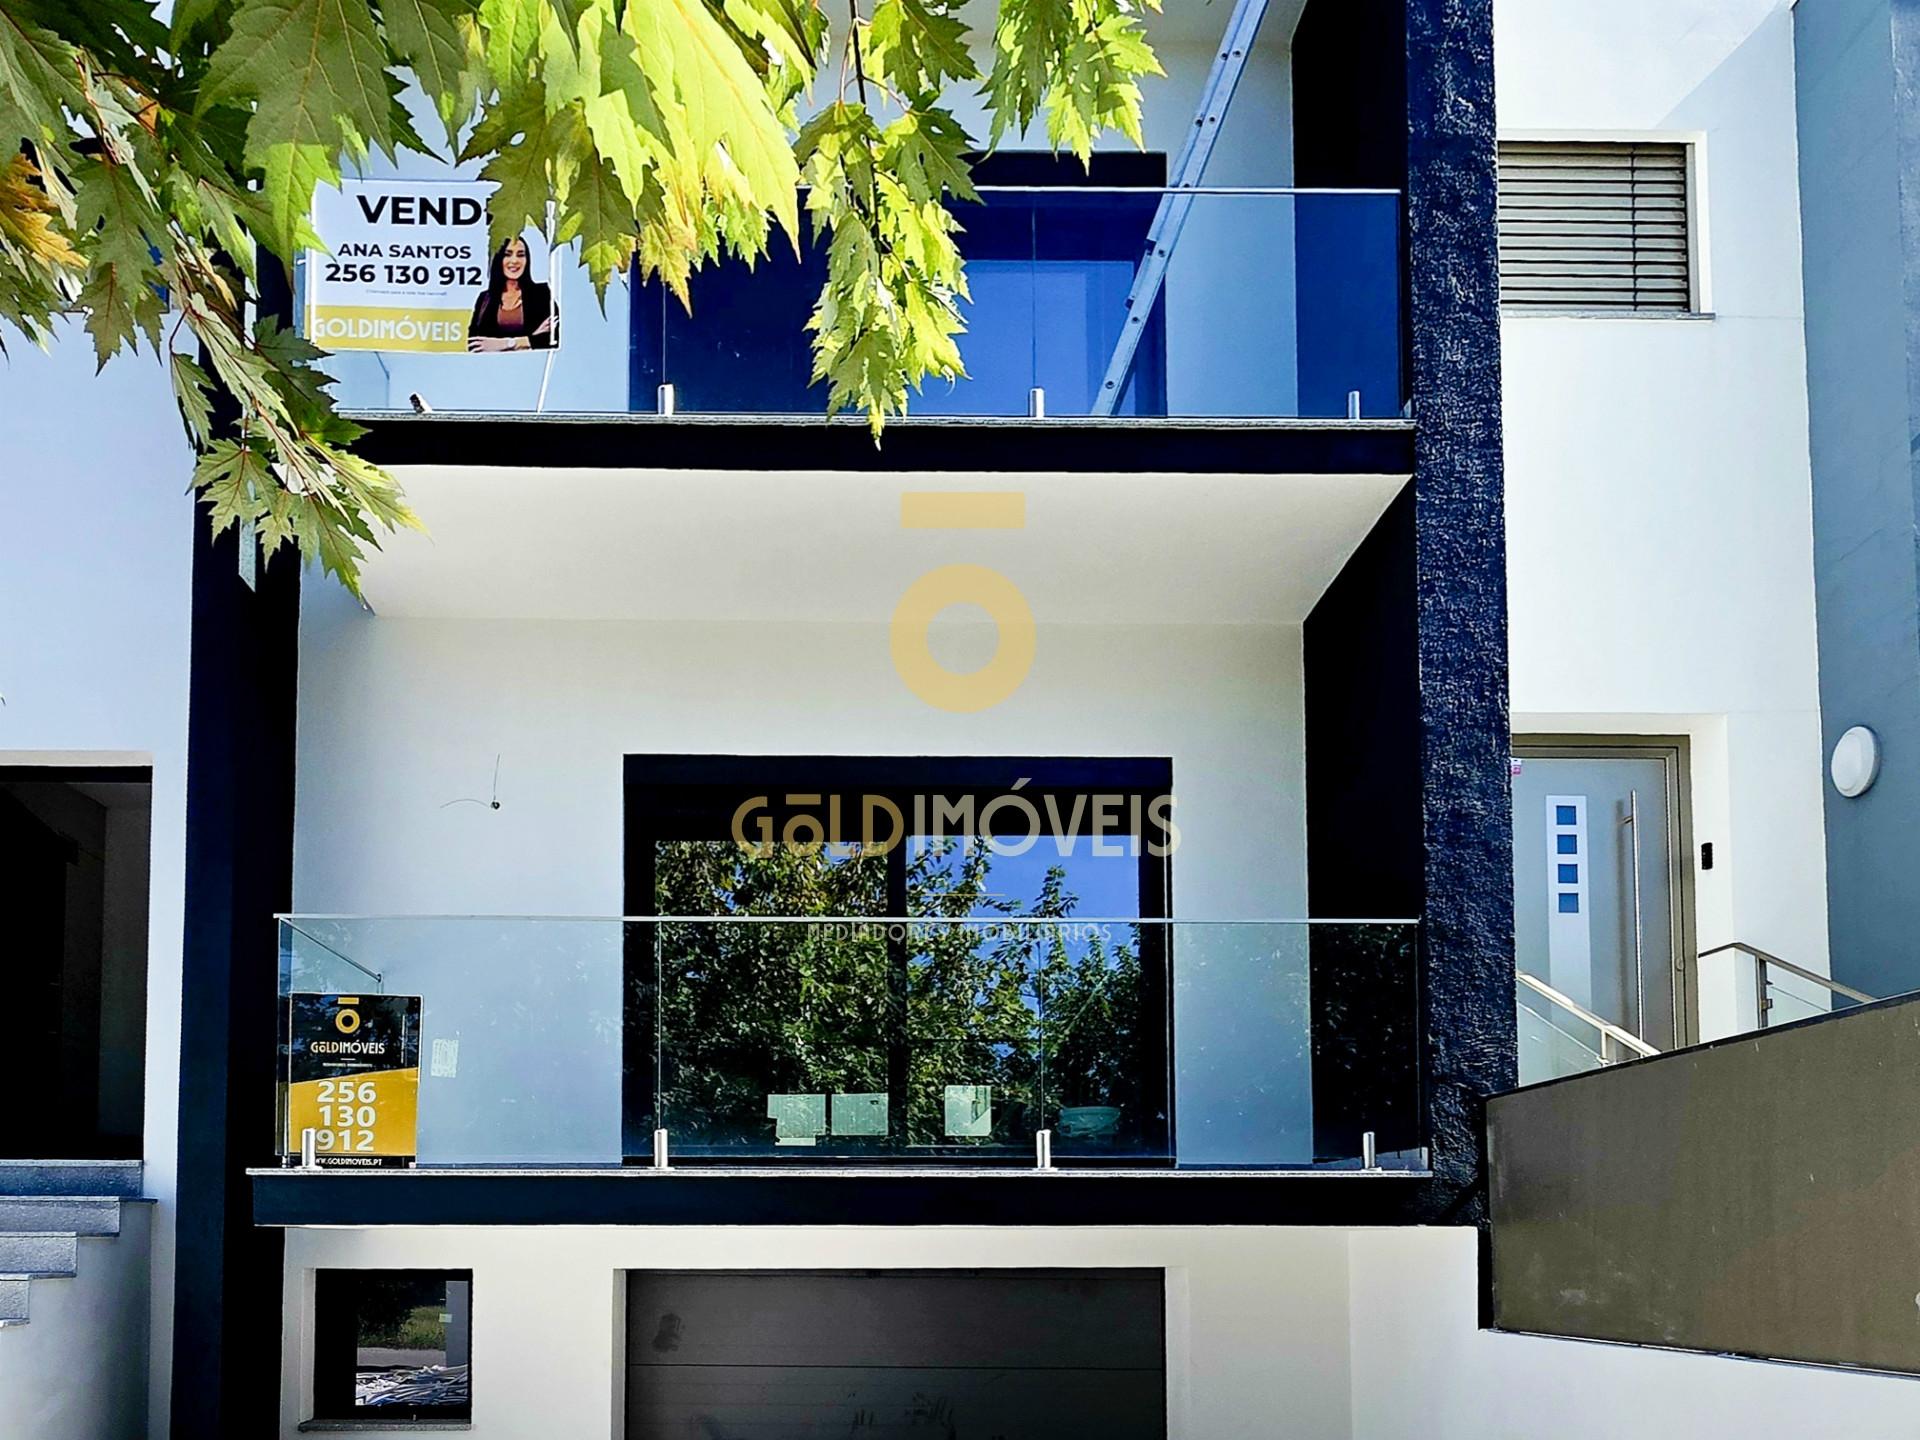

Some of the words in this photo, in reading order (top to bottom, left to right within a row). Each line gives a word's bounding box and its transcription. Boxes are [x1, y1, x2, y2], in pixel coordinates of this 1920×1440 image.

[357, 195, 494, 226] VEND
[338, 243, 383, 258] ANA
[389, 244, 472, 260] SANTOS
[325, 263, 376, 283] 256
[384, 265, 430, 285] 130
[438, 266, 483, 286] 912
[315, 314, 462, 343] GOLDIMÓVEIS
[317, 1081, 377, 1103] 256
[319, 1106, 376, 1127] 130
[316, 1129, 375, 1151] 912
